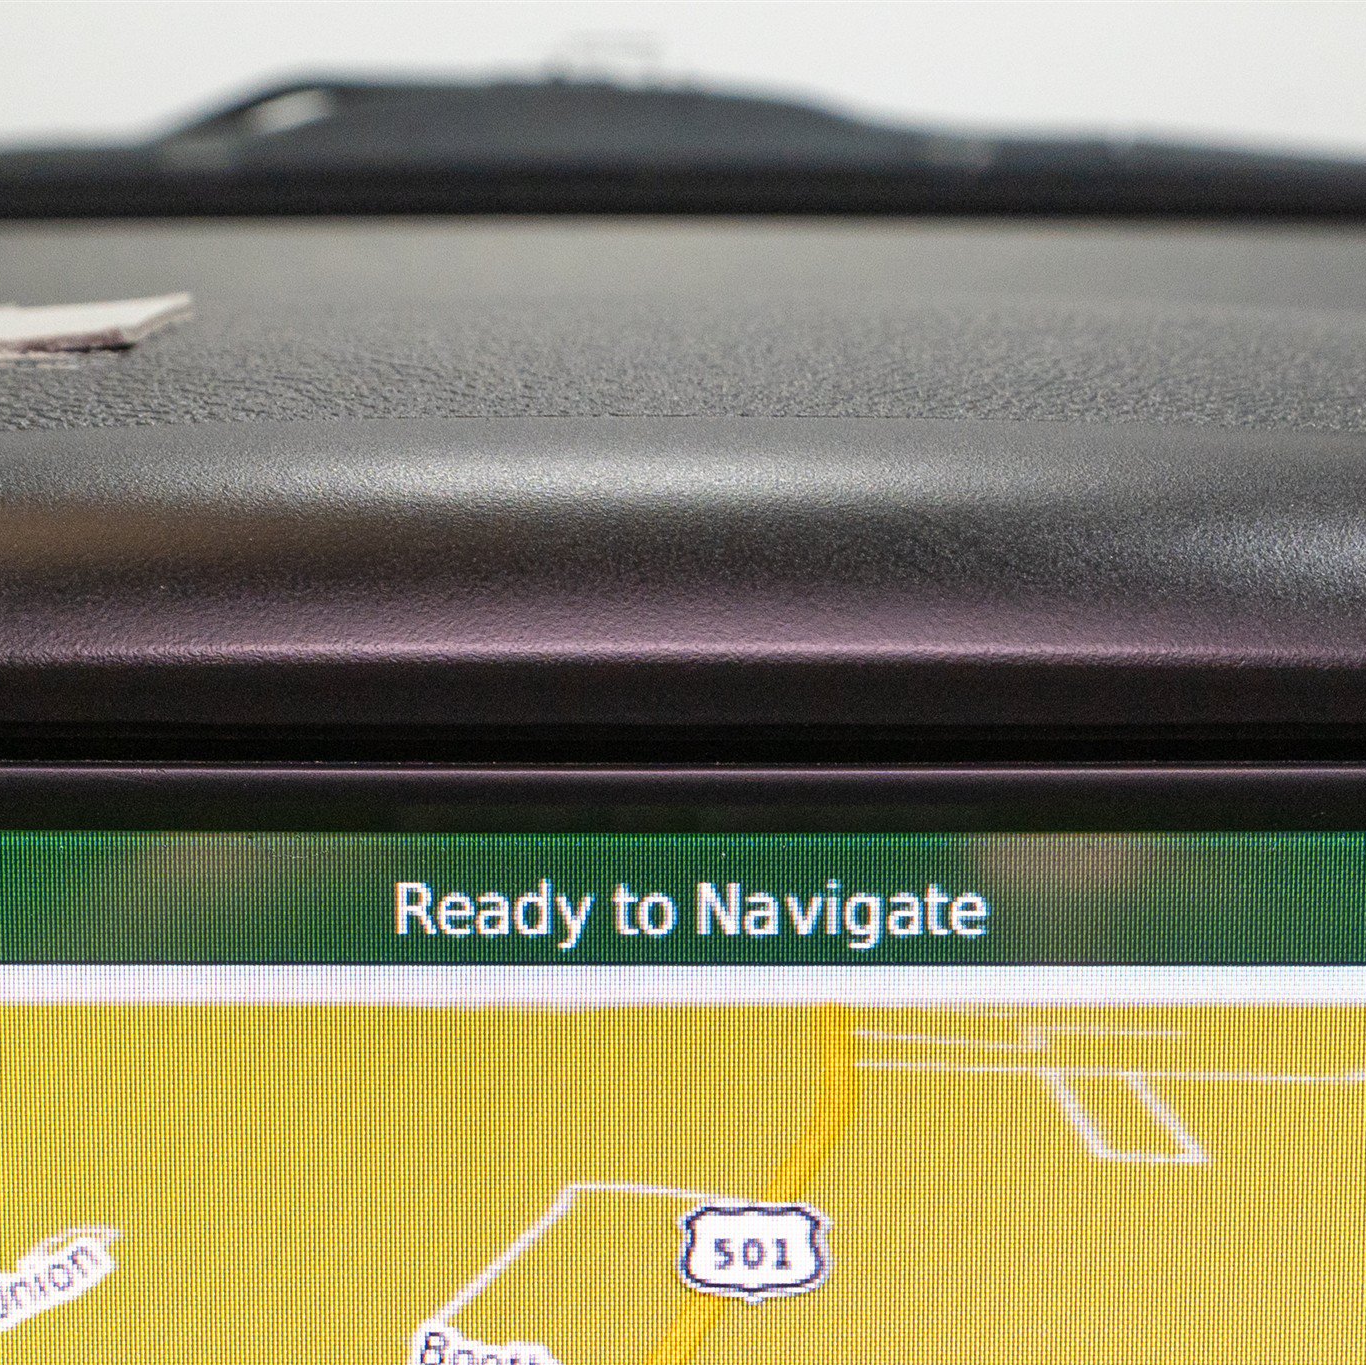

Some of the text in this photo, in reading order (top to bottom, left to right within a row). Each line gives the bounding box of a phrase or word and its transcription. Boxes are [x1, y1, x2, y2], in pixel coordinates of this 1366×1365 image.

[393, 877, 988, 950] Ready to Navigate
[713, 1236, 792, 1270] 501
